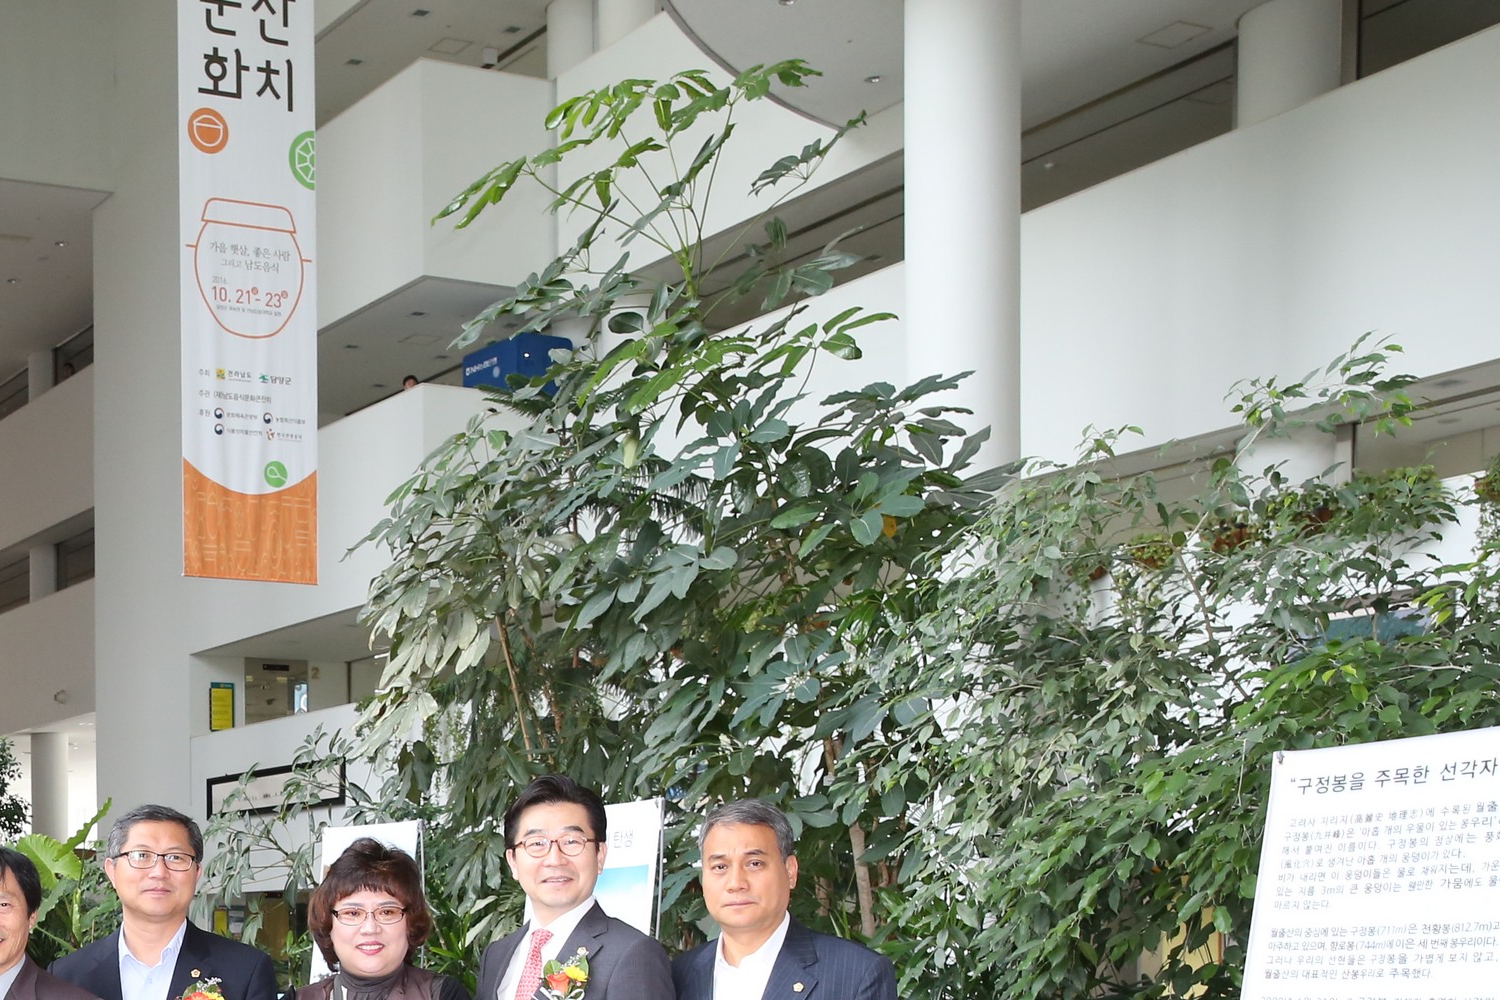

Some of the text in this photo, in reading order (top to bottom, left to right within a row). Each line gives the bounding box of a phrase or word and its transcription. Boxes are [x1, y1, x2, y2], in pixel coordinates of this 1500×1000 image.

[210, 241, 227, 254] 가을
[212, 286, 231, 302] 10.
[1374, 765, 1430, 788] 주목한
[1440, 757, 1498, 782] 선각자
[1290, 818, 1316, 828] 고려사
[1440, 803, 1471, 817] 수록된
[1384, 824, 1402, 835] 개의
[1406, 821, 1435, 834] 우물이
[1439, 820, 1457, 831] 있는
[1281, 845, 1300, 856] 해서
[1305, 843, 1333, 855] 붙여진
[1388, 837, 1429, 849] 구정봉의
[1435, 833, 1477, 847] 정상에는
[1328, 855, 1354, 868] 생겨난
[1357, 854, 1375, 866] 아홉
[1379, 852, 1397, 864] 개의
[1402, 850, 1439, 863] 웅덩이가
[1442, 848, 1466, 860] 있다.
[1277, 873, 1294, 882] 비가
[1300, 871, 1326, 882] 내리면
[1331, 871, 1339, 880] 이
[1345, 868, 1391, 880] 웅덩이들은
[1397, 867, 1415, 878] 물로
[1276, 886, 1292, 897] 있는
[1299, 885, 1315, 897] 지름
[1321, 885, 1344, 895] 3m의
[1350, 884, 1358, 894] 큰
[1364, 882, 1401, 895] 웅덩이는
[1440, 877, 1483, 889] 가뭄에도
[1274, 900, 1300, 910] 마르지
[1271, 927, 1302, 939] 월출산의
[1304, 927, 1329, 938] 중심에
[1331, 926, 1347, 937] 있는
[1350, 923, 1418, 937] 구정봉(711m)은
[1268, 941, 1300, 951] 마주하고
[1417, 938, 1427, 949] 세
[1430, 938, 1448, 949] 번째
[1450, 936, 1498, 949] 봉우리이다.
[1266, 955, 1292, 965] 그러나
[1297, 955, 1323, 965] 우리의
[1329, 954, 1365, 966] 선현들은
[1371, 953, 1408, 965] 구정봉을
[1413, 952, 1444, 964] 가볍게
[1448, 952, 1467, 963] 보지
[1265, 968, 1432, 980] 월출산의 대표적인 산봉우리로 주목했다.
